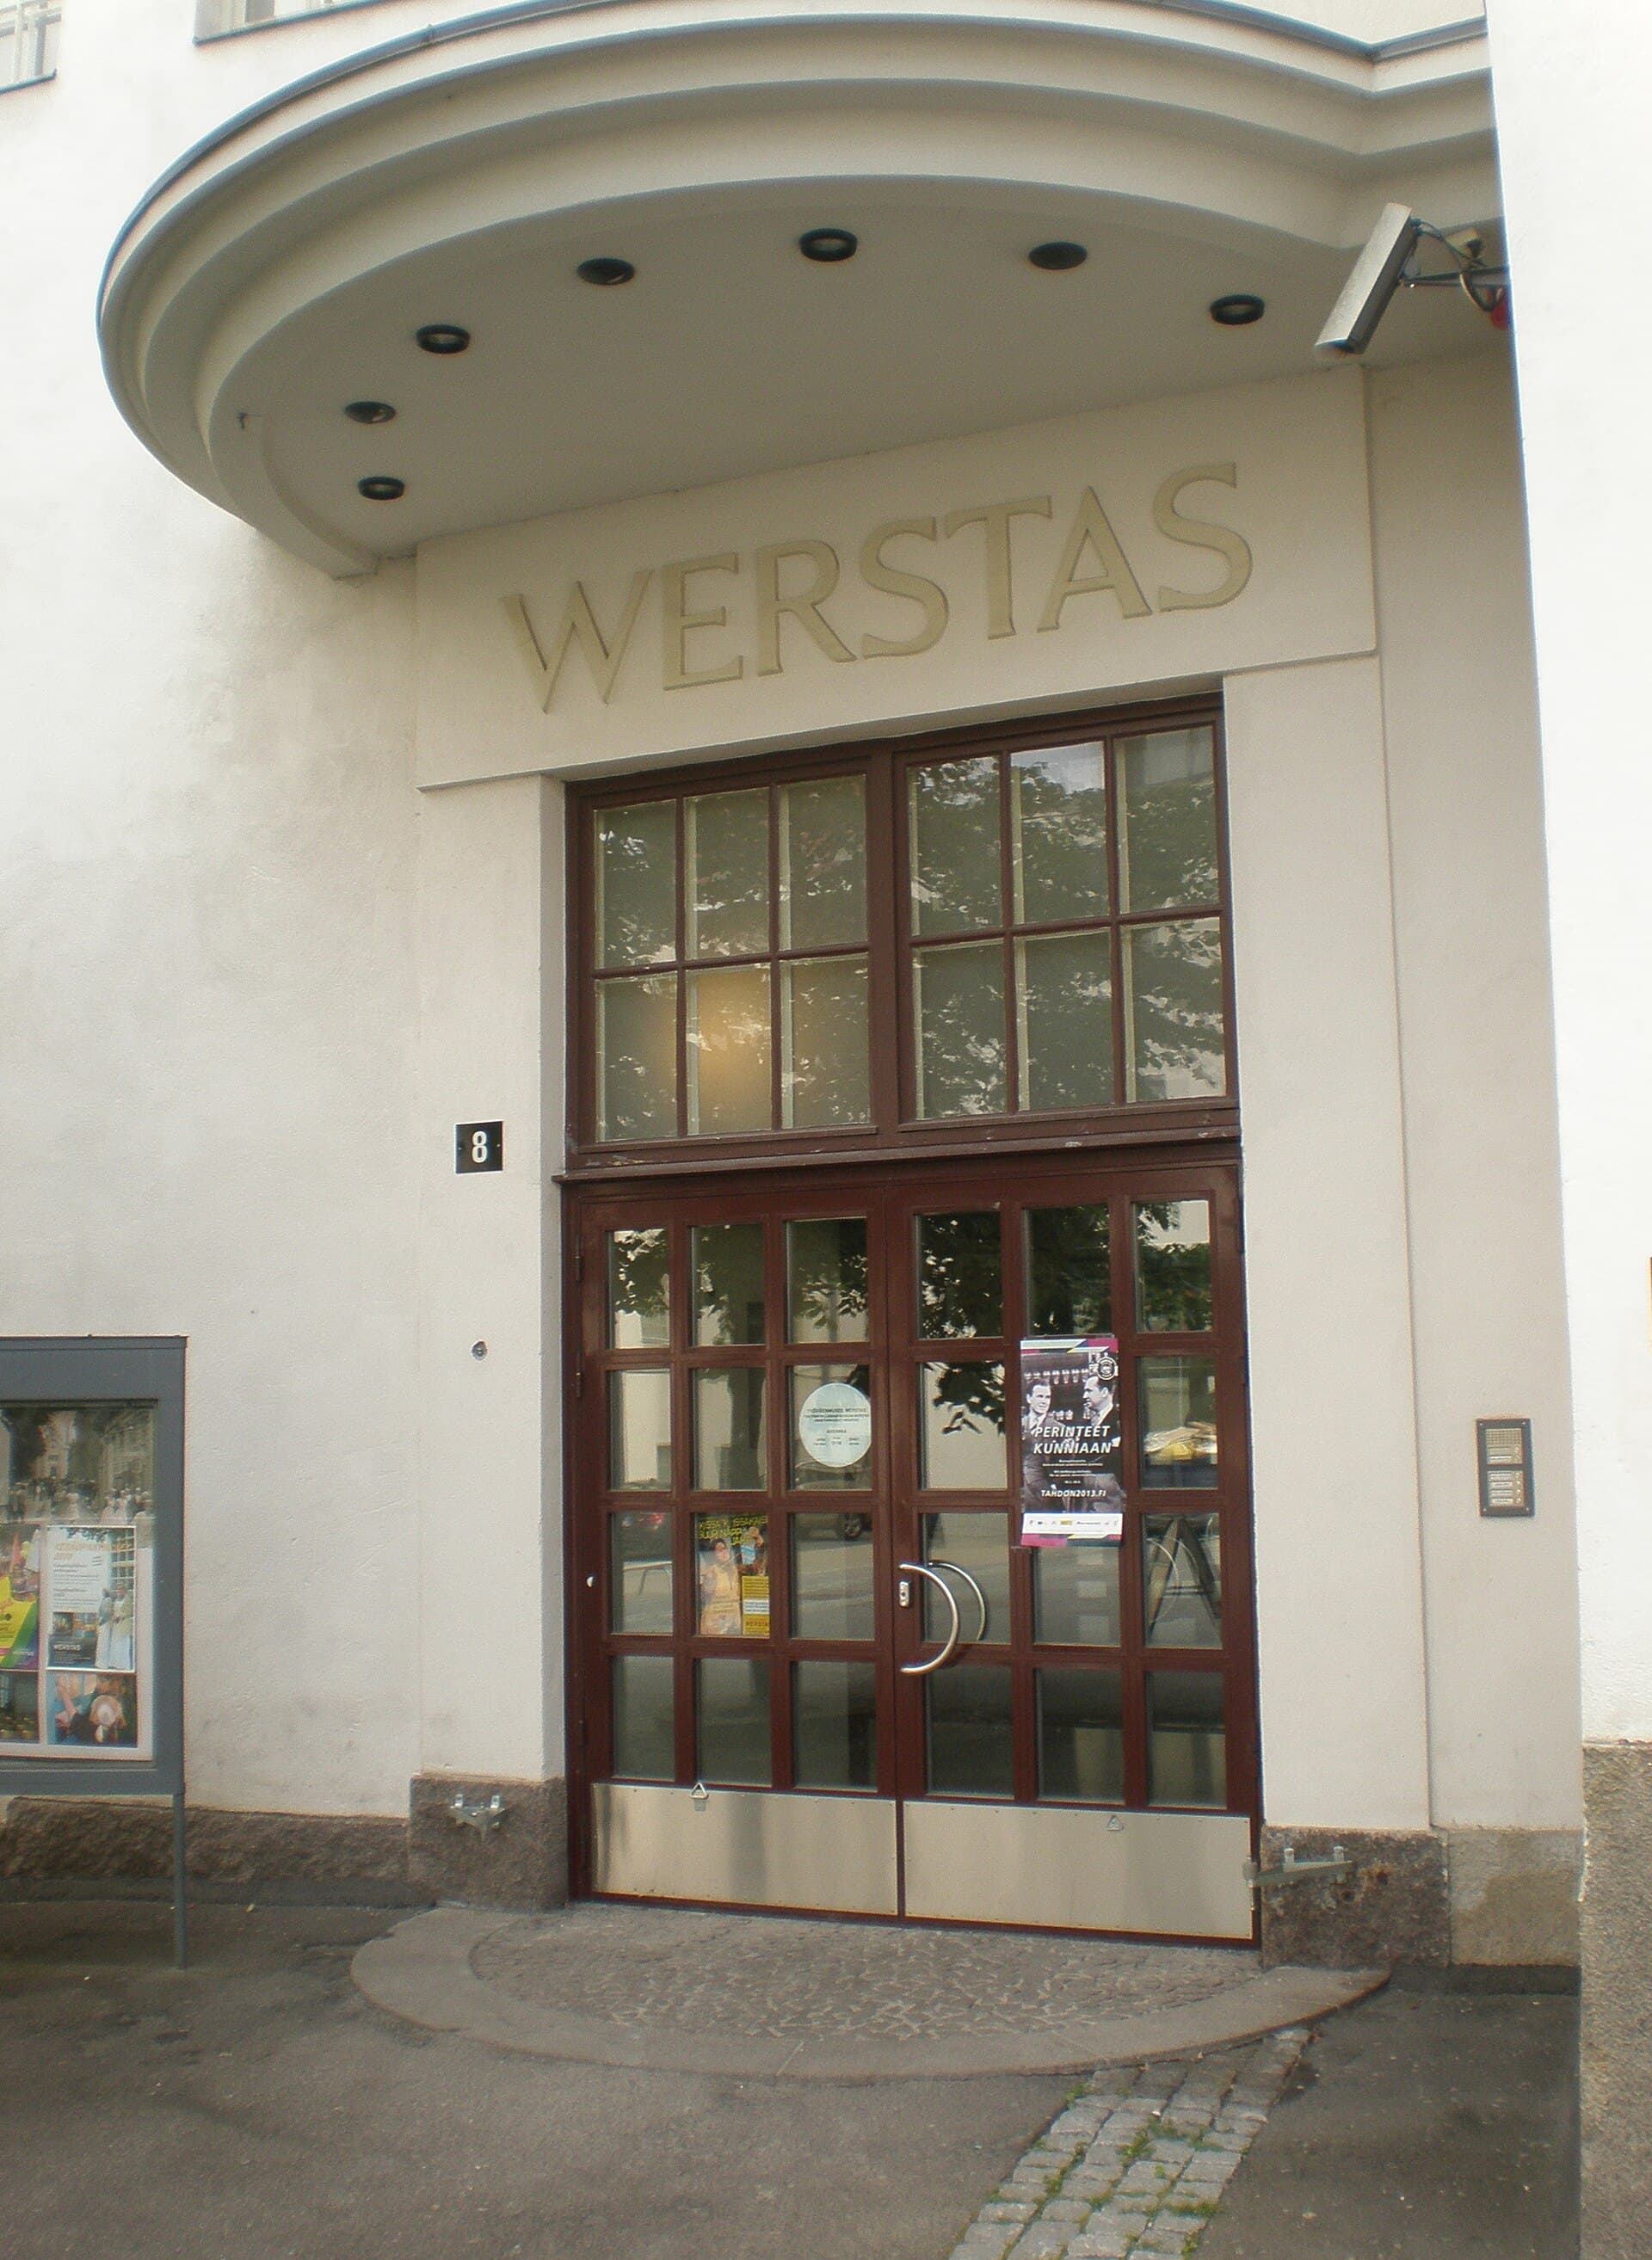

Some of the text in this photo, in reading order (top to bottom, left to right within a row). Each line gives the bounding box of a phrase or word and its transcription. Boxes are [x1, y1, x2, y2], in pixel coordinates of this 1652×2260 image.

[499, 461, 1254, 714] WERSTAS
[472, 1130, 488, 1164] 8
[1034, 1425, 1110, 1438] PERINTEET
[1033, 1442, 1111, 1455] KUNNIAAN
[1040, 1489, 1106, 1499] TAHDON2013.FI
